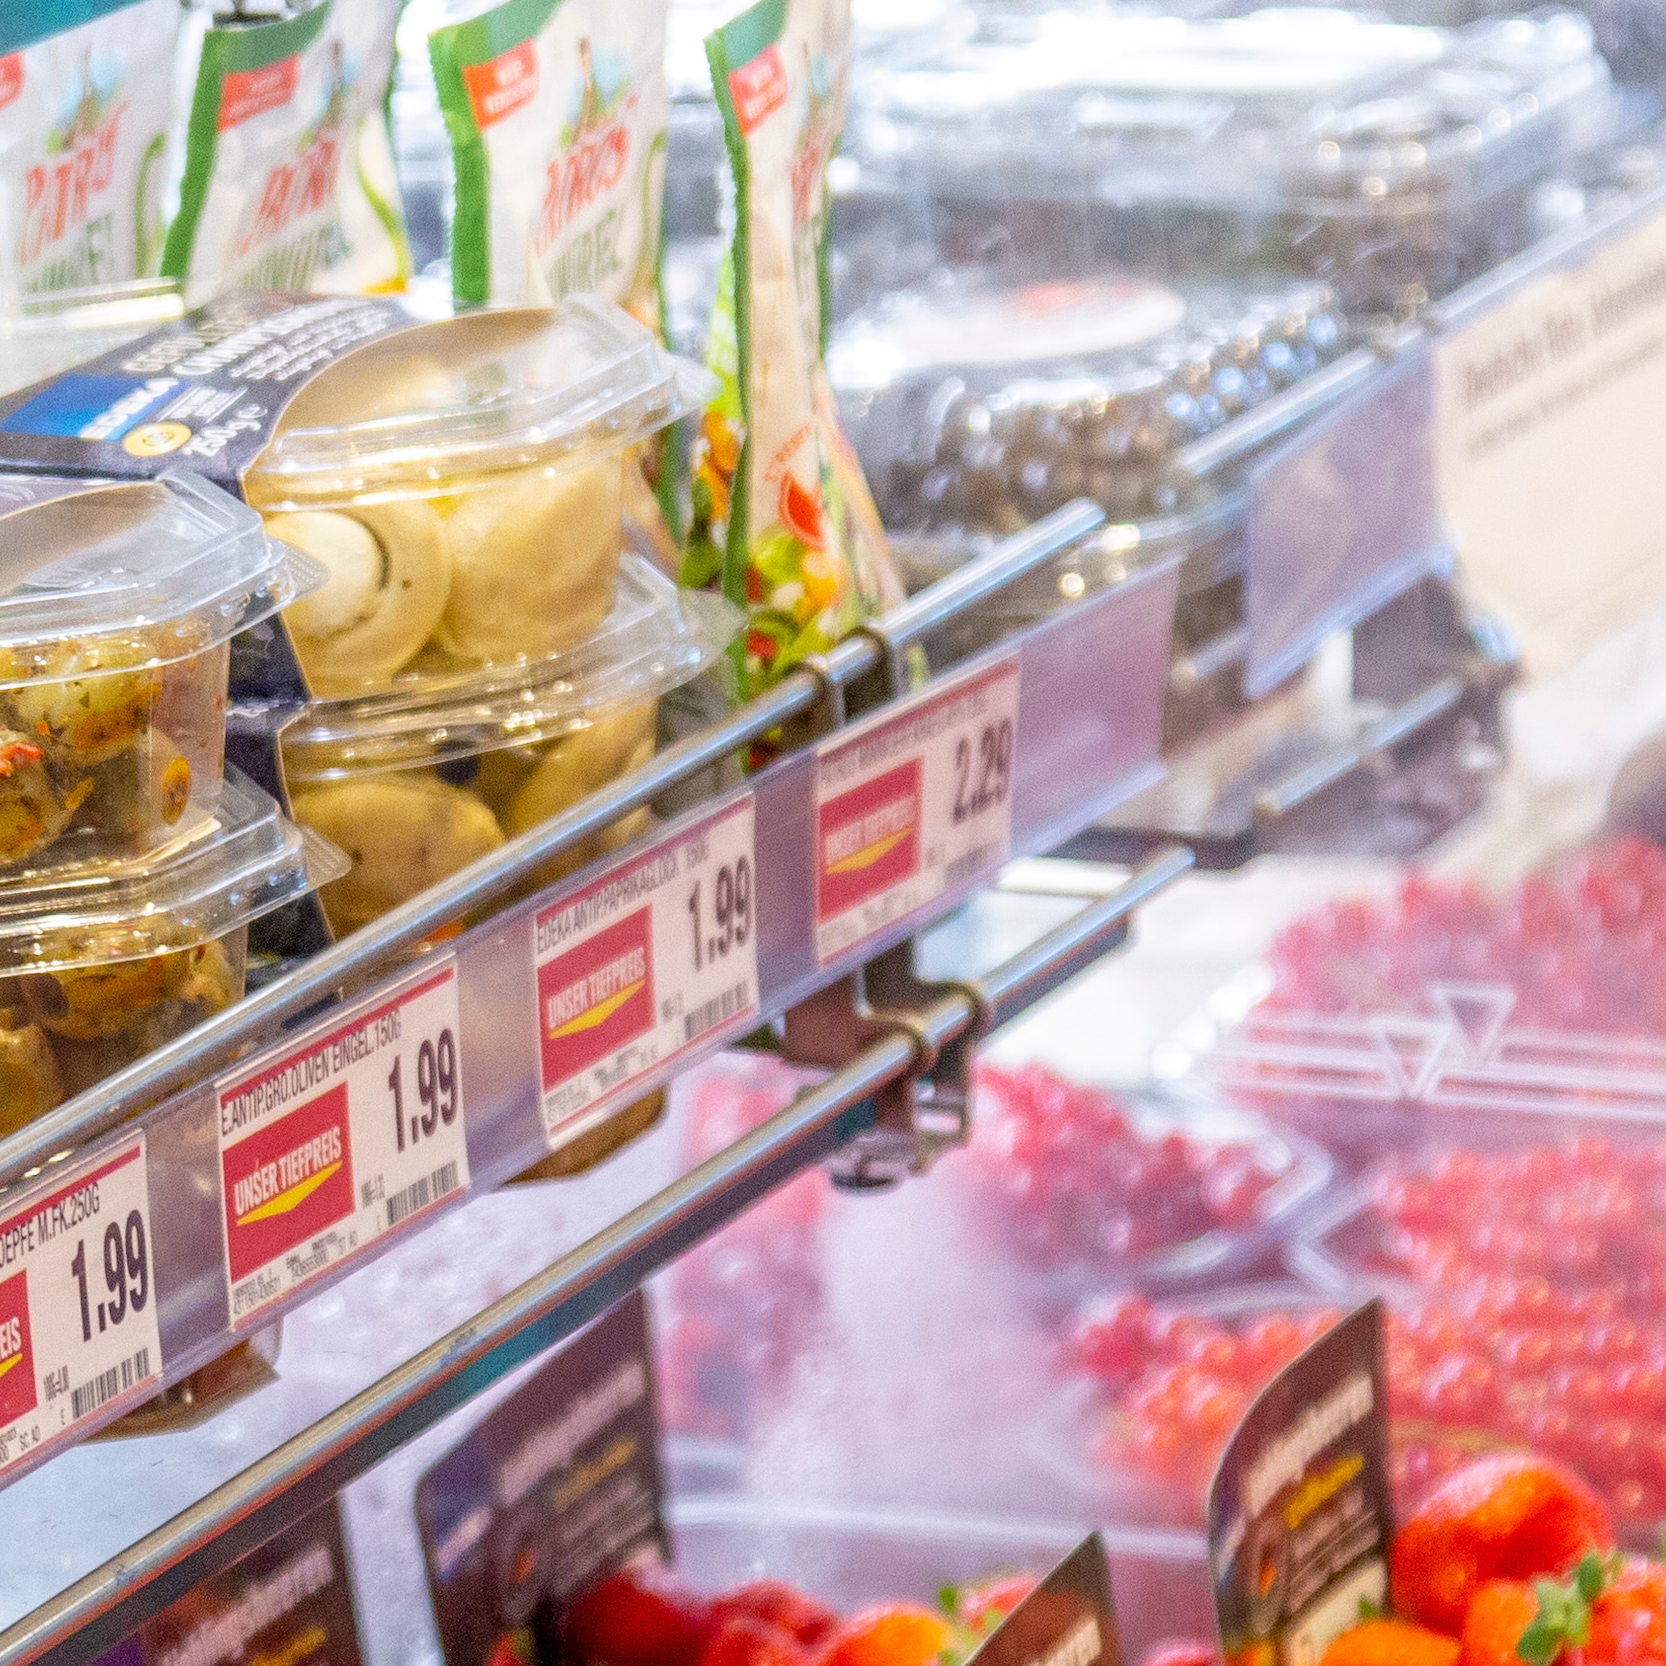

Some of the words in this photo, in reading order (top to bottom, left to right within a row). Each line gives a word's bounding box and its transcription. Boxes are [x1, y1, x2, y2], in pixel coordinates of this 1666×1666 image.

[687, 851, 751, 976] 1.99
[331, 1007, 401, 1074] EINGEL.150G
[547, 976, 589, 1030] UNSER
[387, 1023, 459, 1157] 1.99
[36, 1180, 100, 1245] M.FK.250G
[234, 1160, 278, 1217] UNSER
[278, 1123, 342, 1191] TIEFPREIS
[70, 1204, 150, 1347] 1.99
